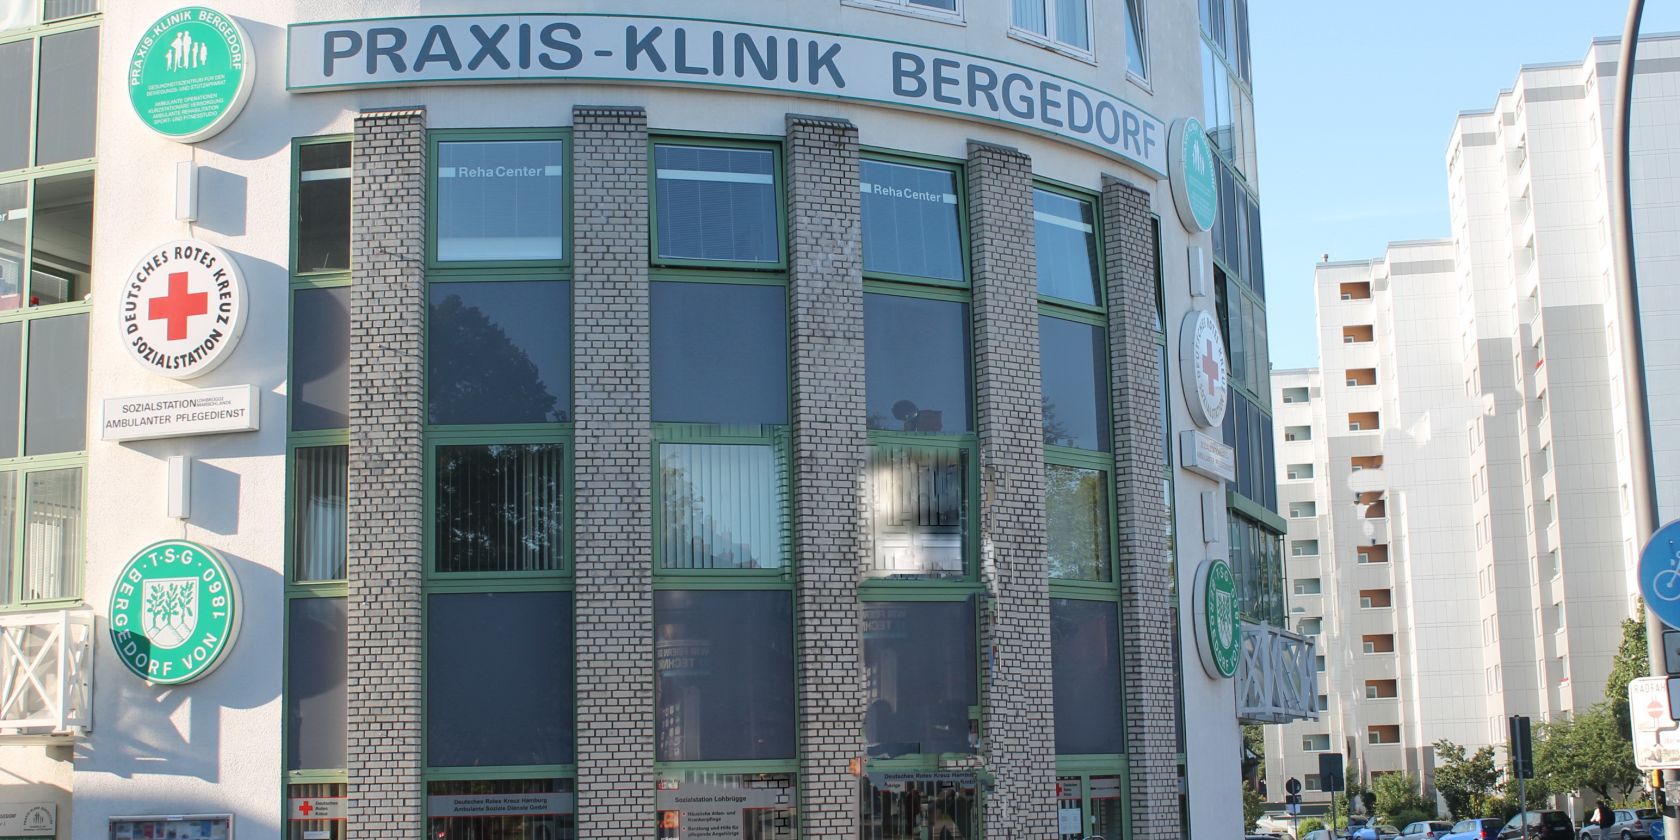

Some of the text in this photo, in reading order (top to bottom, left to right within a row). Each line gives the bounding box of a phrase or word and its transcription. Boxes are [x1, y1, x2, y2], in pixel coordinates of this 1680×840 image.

[131, 10, 241, 86] PRAXIS-KLINIK BERGEDORF
[892, 51, 1155, 160] BERGEDORF
[125, 246, 232, 335] DEUTSCHES ROTES KREUZ
[132, 328, 223, 369] SOZIALSTATION
[106, 408, 246, 429] AMBULANTER PFLEGEDIENST
[122, 399, 197, 414] SOZIALSTATION
[115, 568, 225, 676] BERGEDORF VON 1860
[1634, 683, 1666, 693] RADFAH
